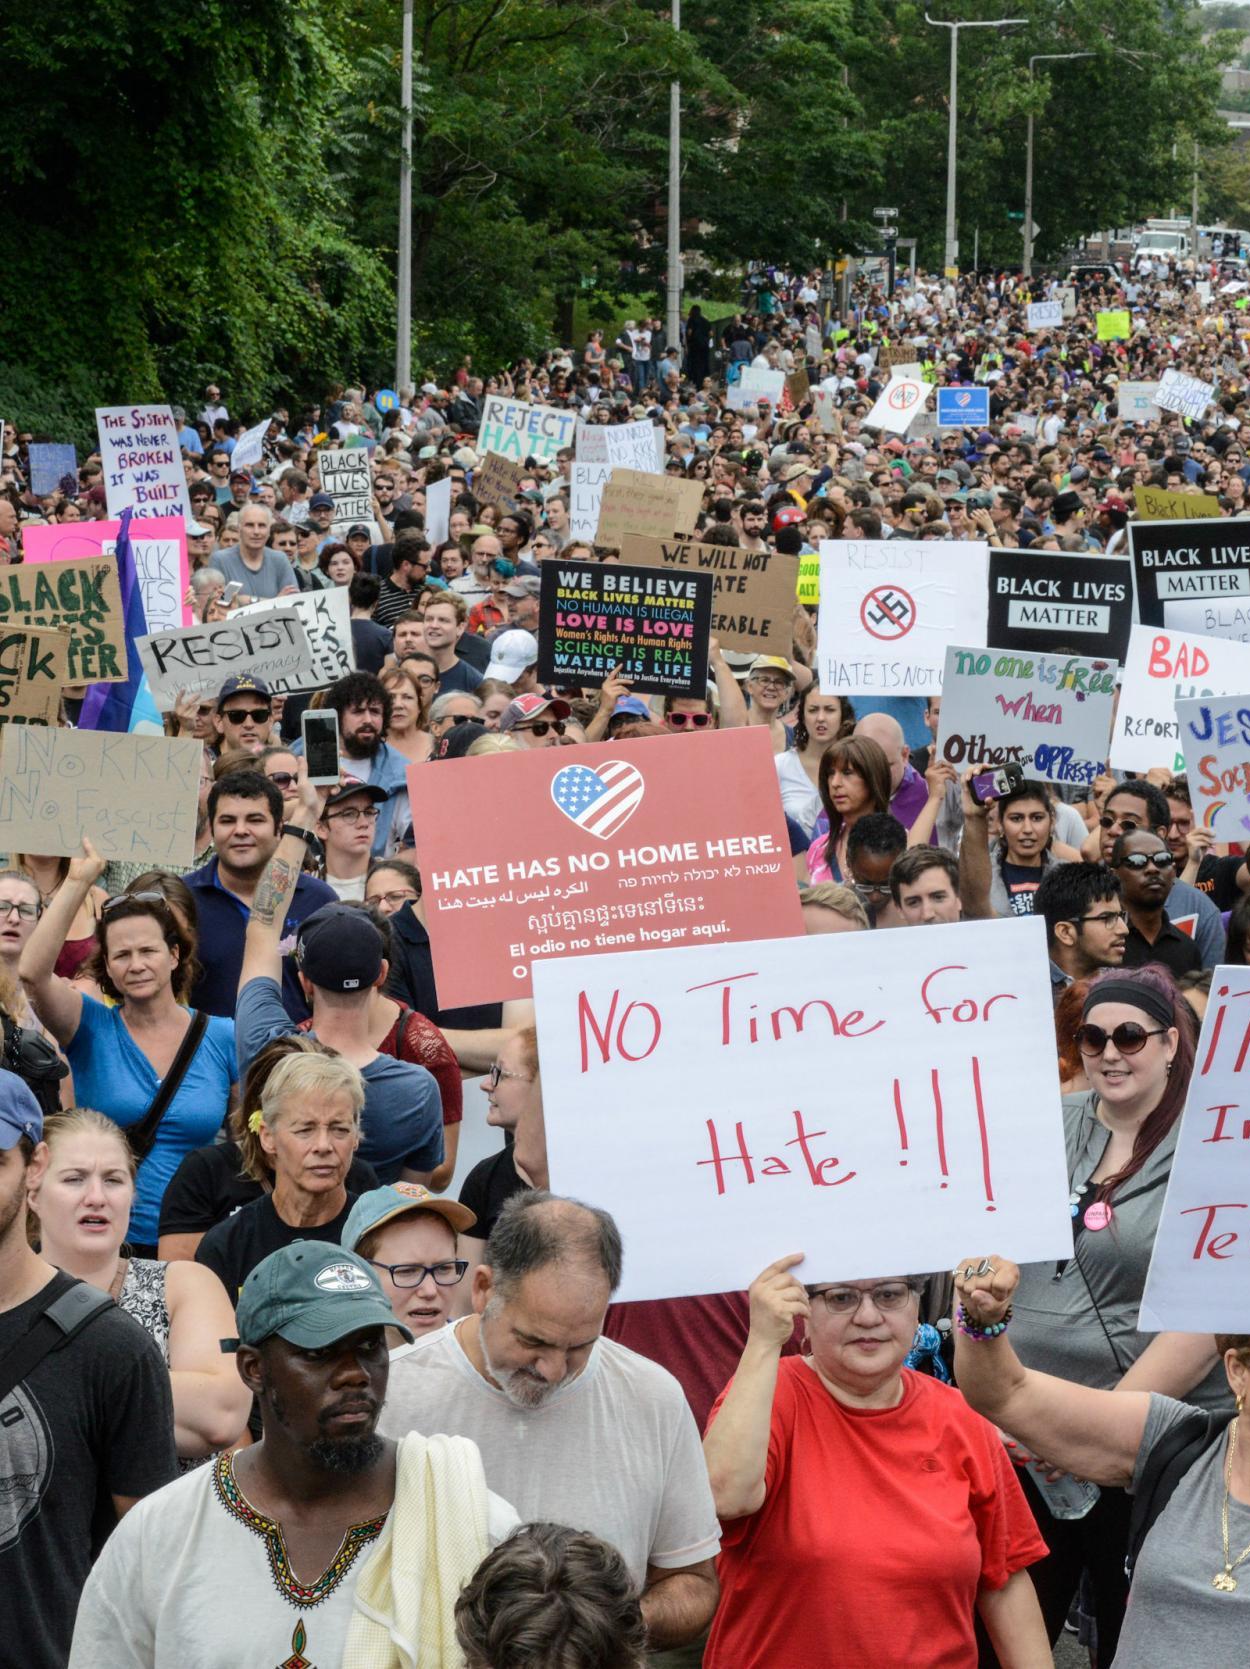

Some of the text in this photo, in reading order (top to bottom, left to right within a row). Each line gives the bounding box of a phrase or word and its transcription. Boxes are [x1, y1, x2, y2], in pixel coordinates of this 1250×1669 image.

[102, 415, 126, 428] THE
[487, 402, 573, 441] REJECT
[109, 437, 132, 448] WAS
[118, 451, 174, 470] BROKEN
[321, 453, 367, 471] BLACK
[110, 470, 160, 487] IT WAS
[323, 472, 369, 492] LIVES
[1143, 494, 1177, 517] Black
[661, 544, 772, 573] WE WILL NOT
[847, 543, 930, 574] RESIST
[1142, 548, 1201, 567] BLACK
[558, 571, 592, 589] WE
[604, 575, 697, 598] BELIEVE
[996, 577, 1126, 602] BLACK LIVES
[1168, 574, 1240, 593] MATTER
[557, 588, 695, 609] BLACK LIVES MATTER
[556, 600, 694, 622] NO HUMAN IS ILLEGAL
[1019, 606, 1099, 628] MATTER
[556, 612, 693, 637] LOVE IS LOVE
[150, 617, 296, 674] RESIST
[555, 628, 692, 650] Women's Rights Are Human Rights
[555, 640, 692, 664] SCIENCE IS REAL
[1148, 635, 1210, 680] BAD
[554, 654, 692, 677] WATER IS LIFE
[577, 668, 604, 677] Anywhere
[660, 676, 691, 685] Everywhere
[827, 659, 878, 687] HATE
[955, 650, 1057, 684] no one is
[1020, 753, 1033, 767] are
[76, 789, 188, 832] Fascist
[431, 834, 783, 891] HATE HAS NO HOME HERE.
[617, 862, 781, 889] שנאה לא יכולה לחיות פה
[437, 881, 589, 911] الكره ليس له بيت هنا
[510, 920, 731, 958] El odio no tiene hogar aquí.
[685, 971, 887, 1047] Time
[920, 965, 1018, 1025] for
